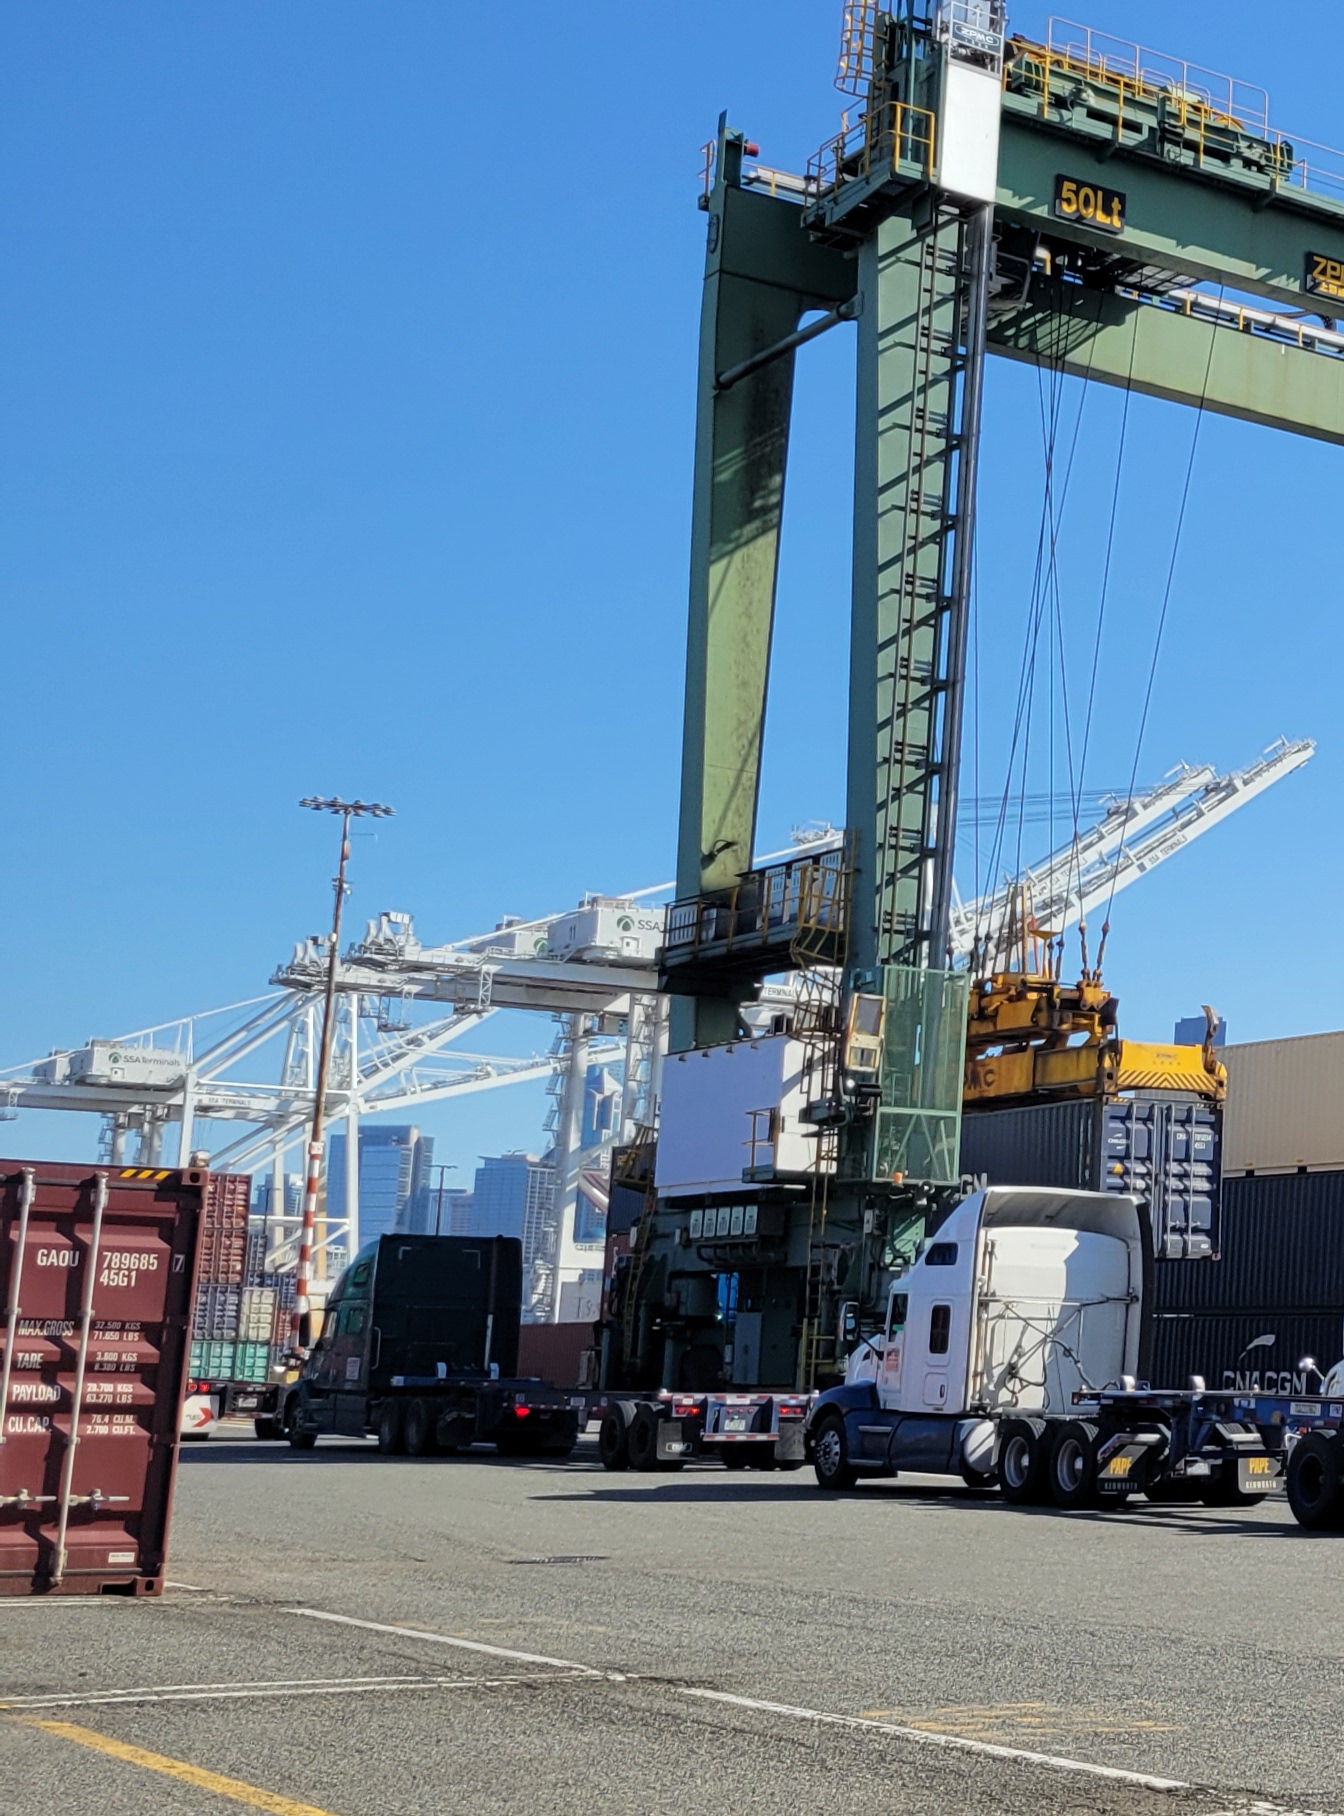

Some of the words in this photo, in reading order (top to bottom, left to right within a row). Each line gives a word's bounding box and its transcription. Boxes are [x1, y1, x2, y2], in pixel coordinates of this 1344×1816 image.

[960, 26, 994, 43] ZPMC
[1061, 181, 1122, 228] 50Lt
[37, 1249, 80, 1268] GAOU
[102, 1251, 159, 1270] 789685
[99, 1269, 137, 1287] 45G1
[18, 1319, 75, 1337] MAX.GROSS
[94, 1321, 122, 1330] 32.500
[124, 1322, 141, 1330] KGS
[123, 1332, 139, 1341] LBS
[16, 1352, 45, 1369] TARE
[121, 1352, 138, 1362] KGS
[119, 1363, 136, 1372] LBS
[12, 1384, 61, 1401] PAYLOAD
[86, 1382, 114, 1392] 28.700
[116, 1383, 134, 1393] KGS
[86, 1393, 113, 1403] 63.270
[116, 1394, 133, 1403] LBS
[91, 1414, 110, 1424] 76.4
[86, 1425, 109, 1434] 2.700
